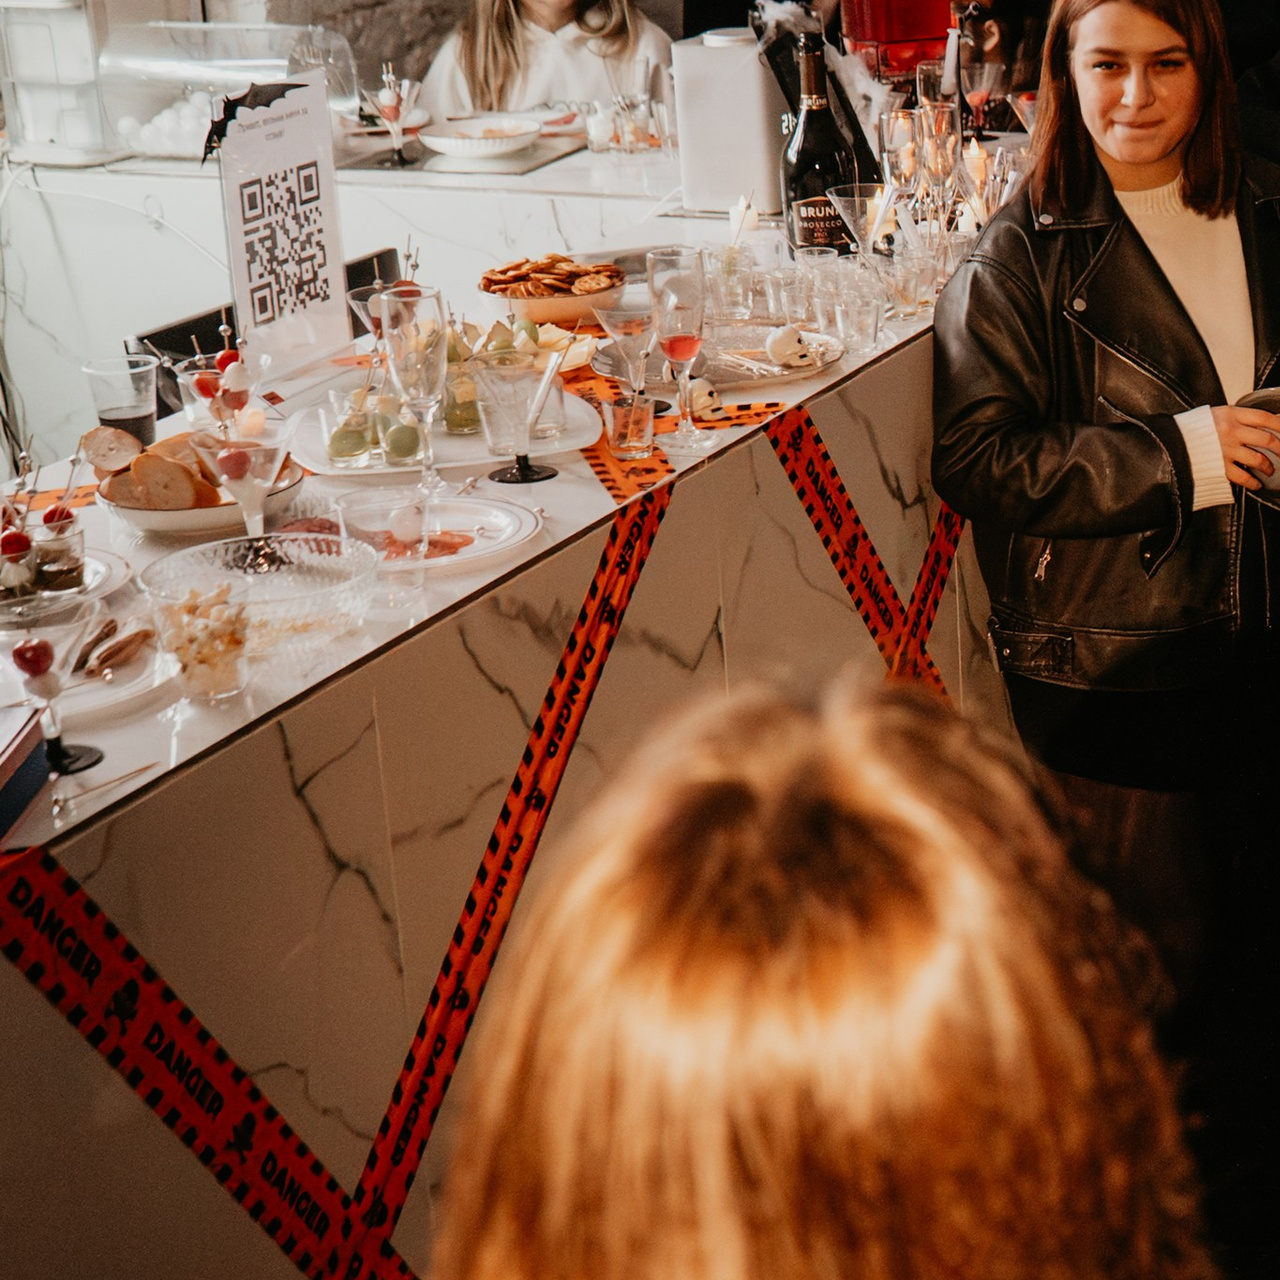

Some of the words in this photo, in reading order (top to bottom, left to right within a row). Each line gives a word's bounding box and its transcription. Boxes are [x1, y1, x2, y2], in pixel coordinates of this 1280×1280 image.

[799, 219, 843, 230] PROSECCO
[800, 206, 840, 218] BRUN
[806, 456, 843, 534] DANGER
[546, 639, 597, 760] DANGER
[7, 875, 103, 989] DANGER
[143, 1021, 225, 1122] DANGER
[260, 1149, 331, 1244] DANGER
